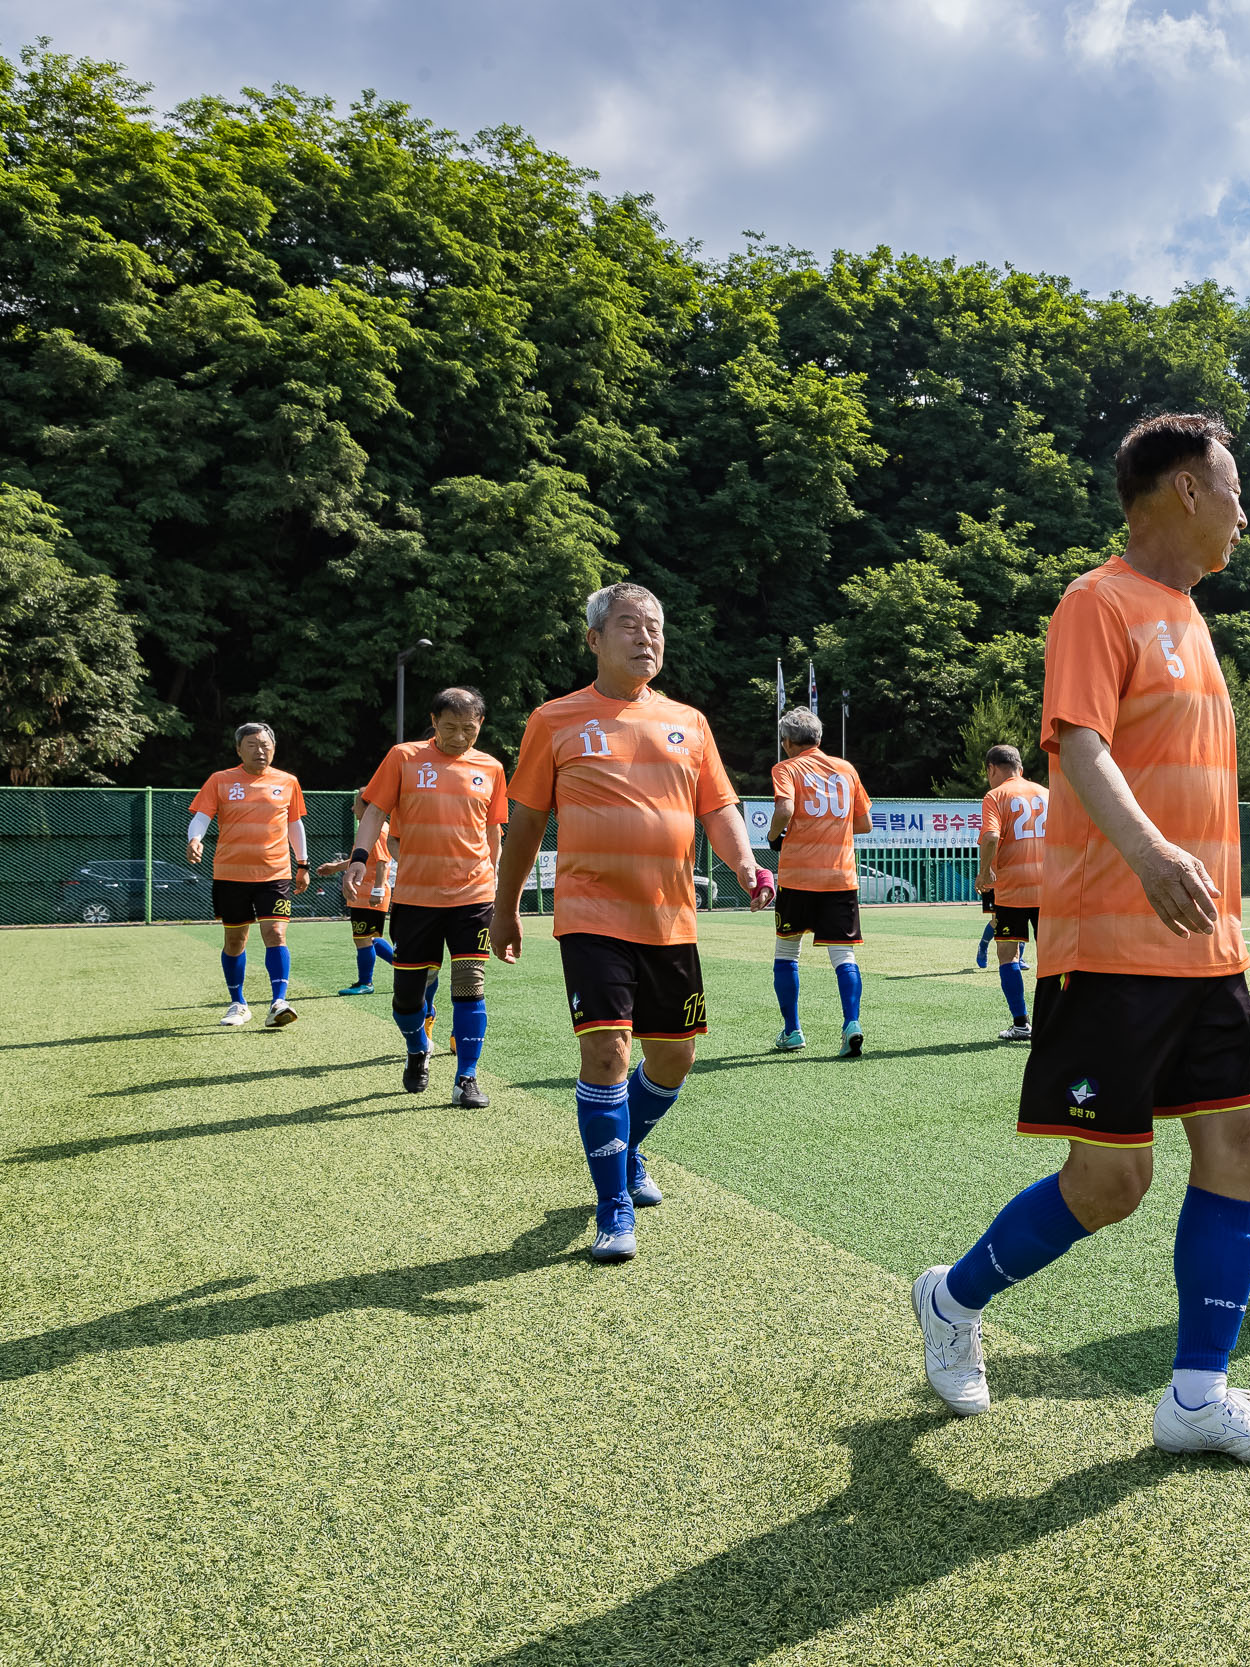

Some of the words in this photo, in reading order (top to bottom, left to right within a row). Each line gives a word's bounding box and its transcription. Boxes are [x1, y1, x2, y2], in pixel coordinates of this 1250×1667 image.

[1160, 640, 1185, 679] 5
[580, 731, 612, 757] 11
[229, 787, 245, 800] 25
[416, 770, 438, 788] 12
[804, 773, 850, 818] 30
[1010, 796, 1048, 840] 22
[684, 993, 706, 1026] 11
[1085, 1110, 1096, 1119] 70
